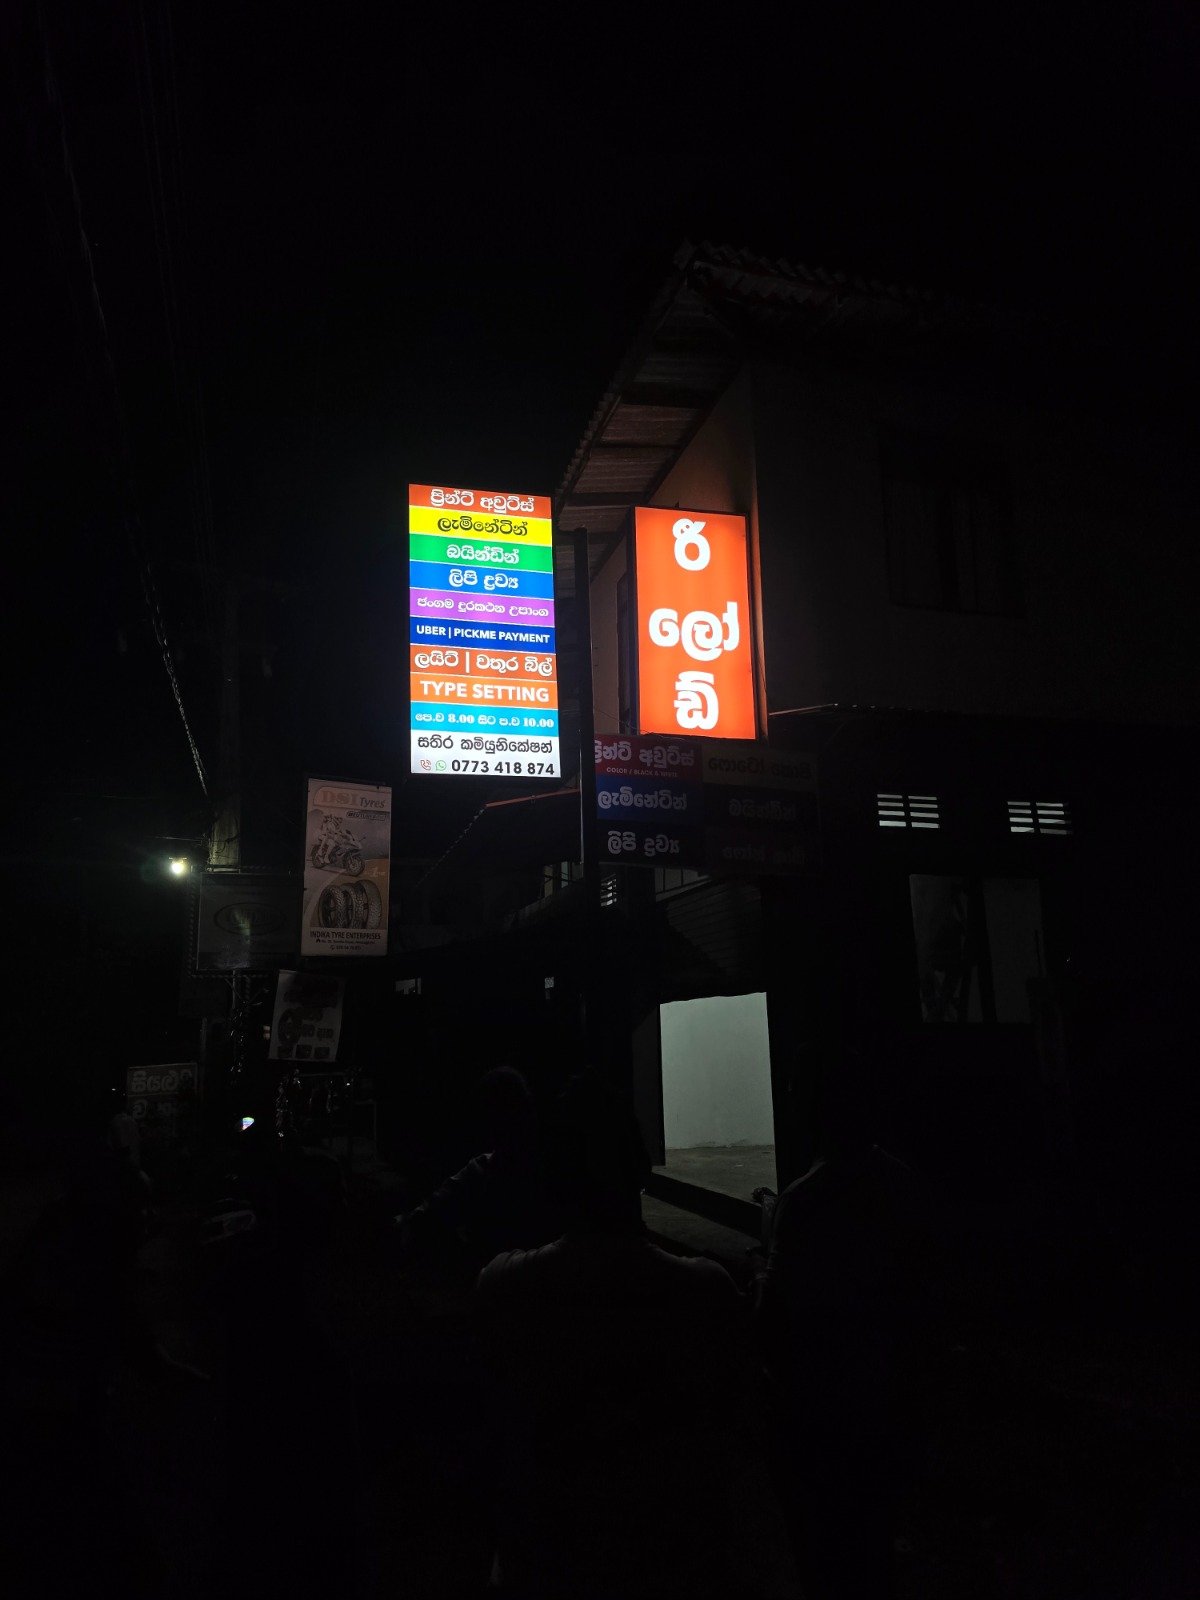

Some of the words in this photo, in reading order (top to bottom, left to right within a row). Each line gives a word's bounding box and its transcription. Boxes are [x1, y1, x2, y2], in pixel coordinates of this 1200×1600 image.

[448, 569, 478, 587] ලිපි
[417, 597, 454, 609] ජංගම
[458, 602, 505, 613] දුරකථන
[509, 605, 549, 616] උපාංග
[416, 625, 446, 636] UBER
[454, 628, 497, 640] PICKME
[499, 631, 551, 643] PAYMENT
[414, 650, 459, 669] ලයිට්
[476, 654, 519, 673] වතුර
[524, 657, 553, 677] බිල්
[420, 681, 467, 698] TYPE
[472, 684, 550, 703] SETTING
[448, 715, 475, 724] 8.00
[523, 718, 554, 728] 10.00
[451, 760, 489, 773] 0773
[494, 761, 522, 774] 418
[527, 763, 555, 775] 874
[359, 797, 386, 808] Tyres
[607, 830, 637, 855] ලිපි
[331, 931, 345, 939] TYRE
